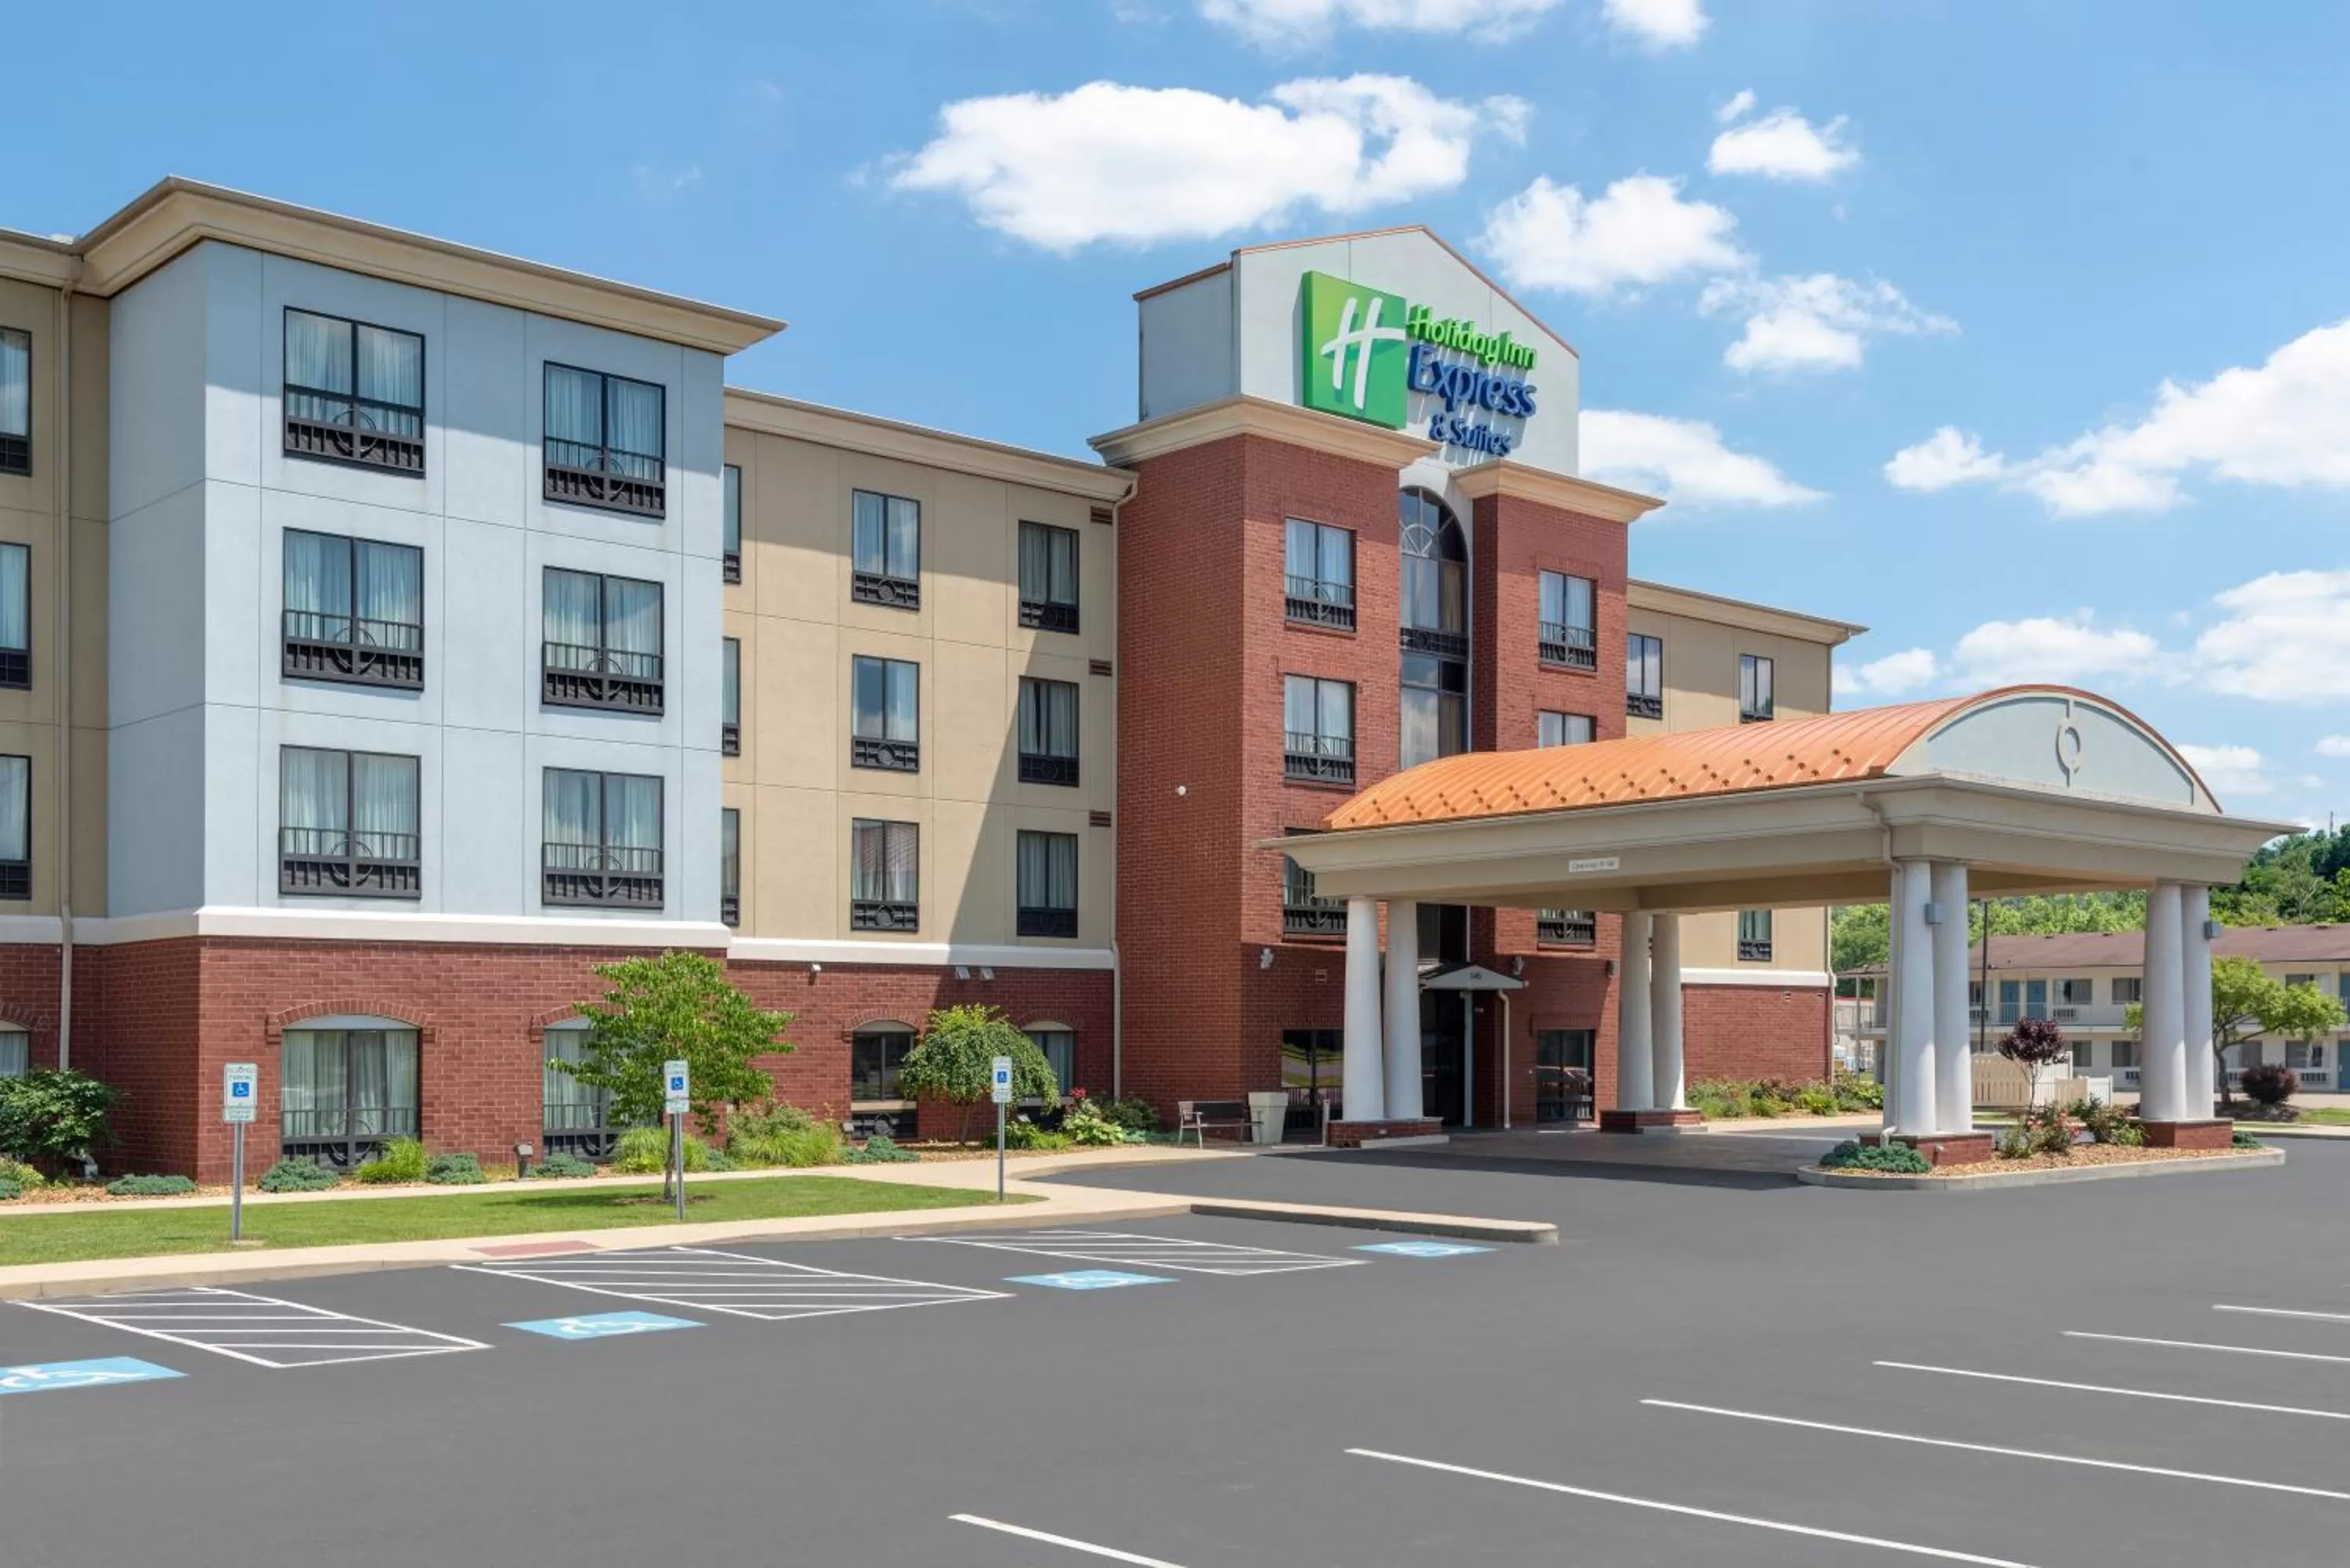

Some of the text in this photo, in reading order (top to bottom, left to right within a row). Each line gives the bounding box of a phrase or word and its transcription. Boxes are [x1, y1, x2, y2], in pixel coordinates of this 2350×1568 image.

[1406, 304, 1537, 370] Holiday Inn
[1408, 345, 1537, 418] Express
[1429, 413, 1511, 457] & Suites
